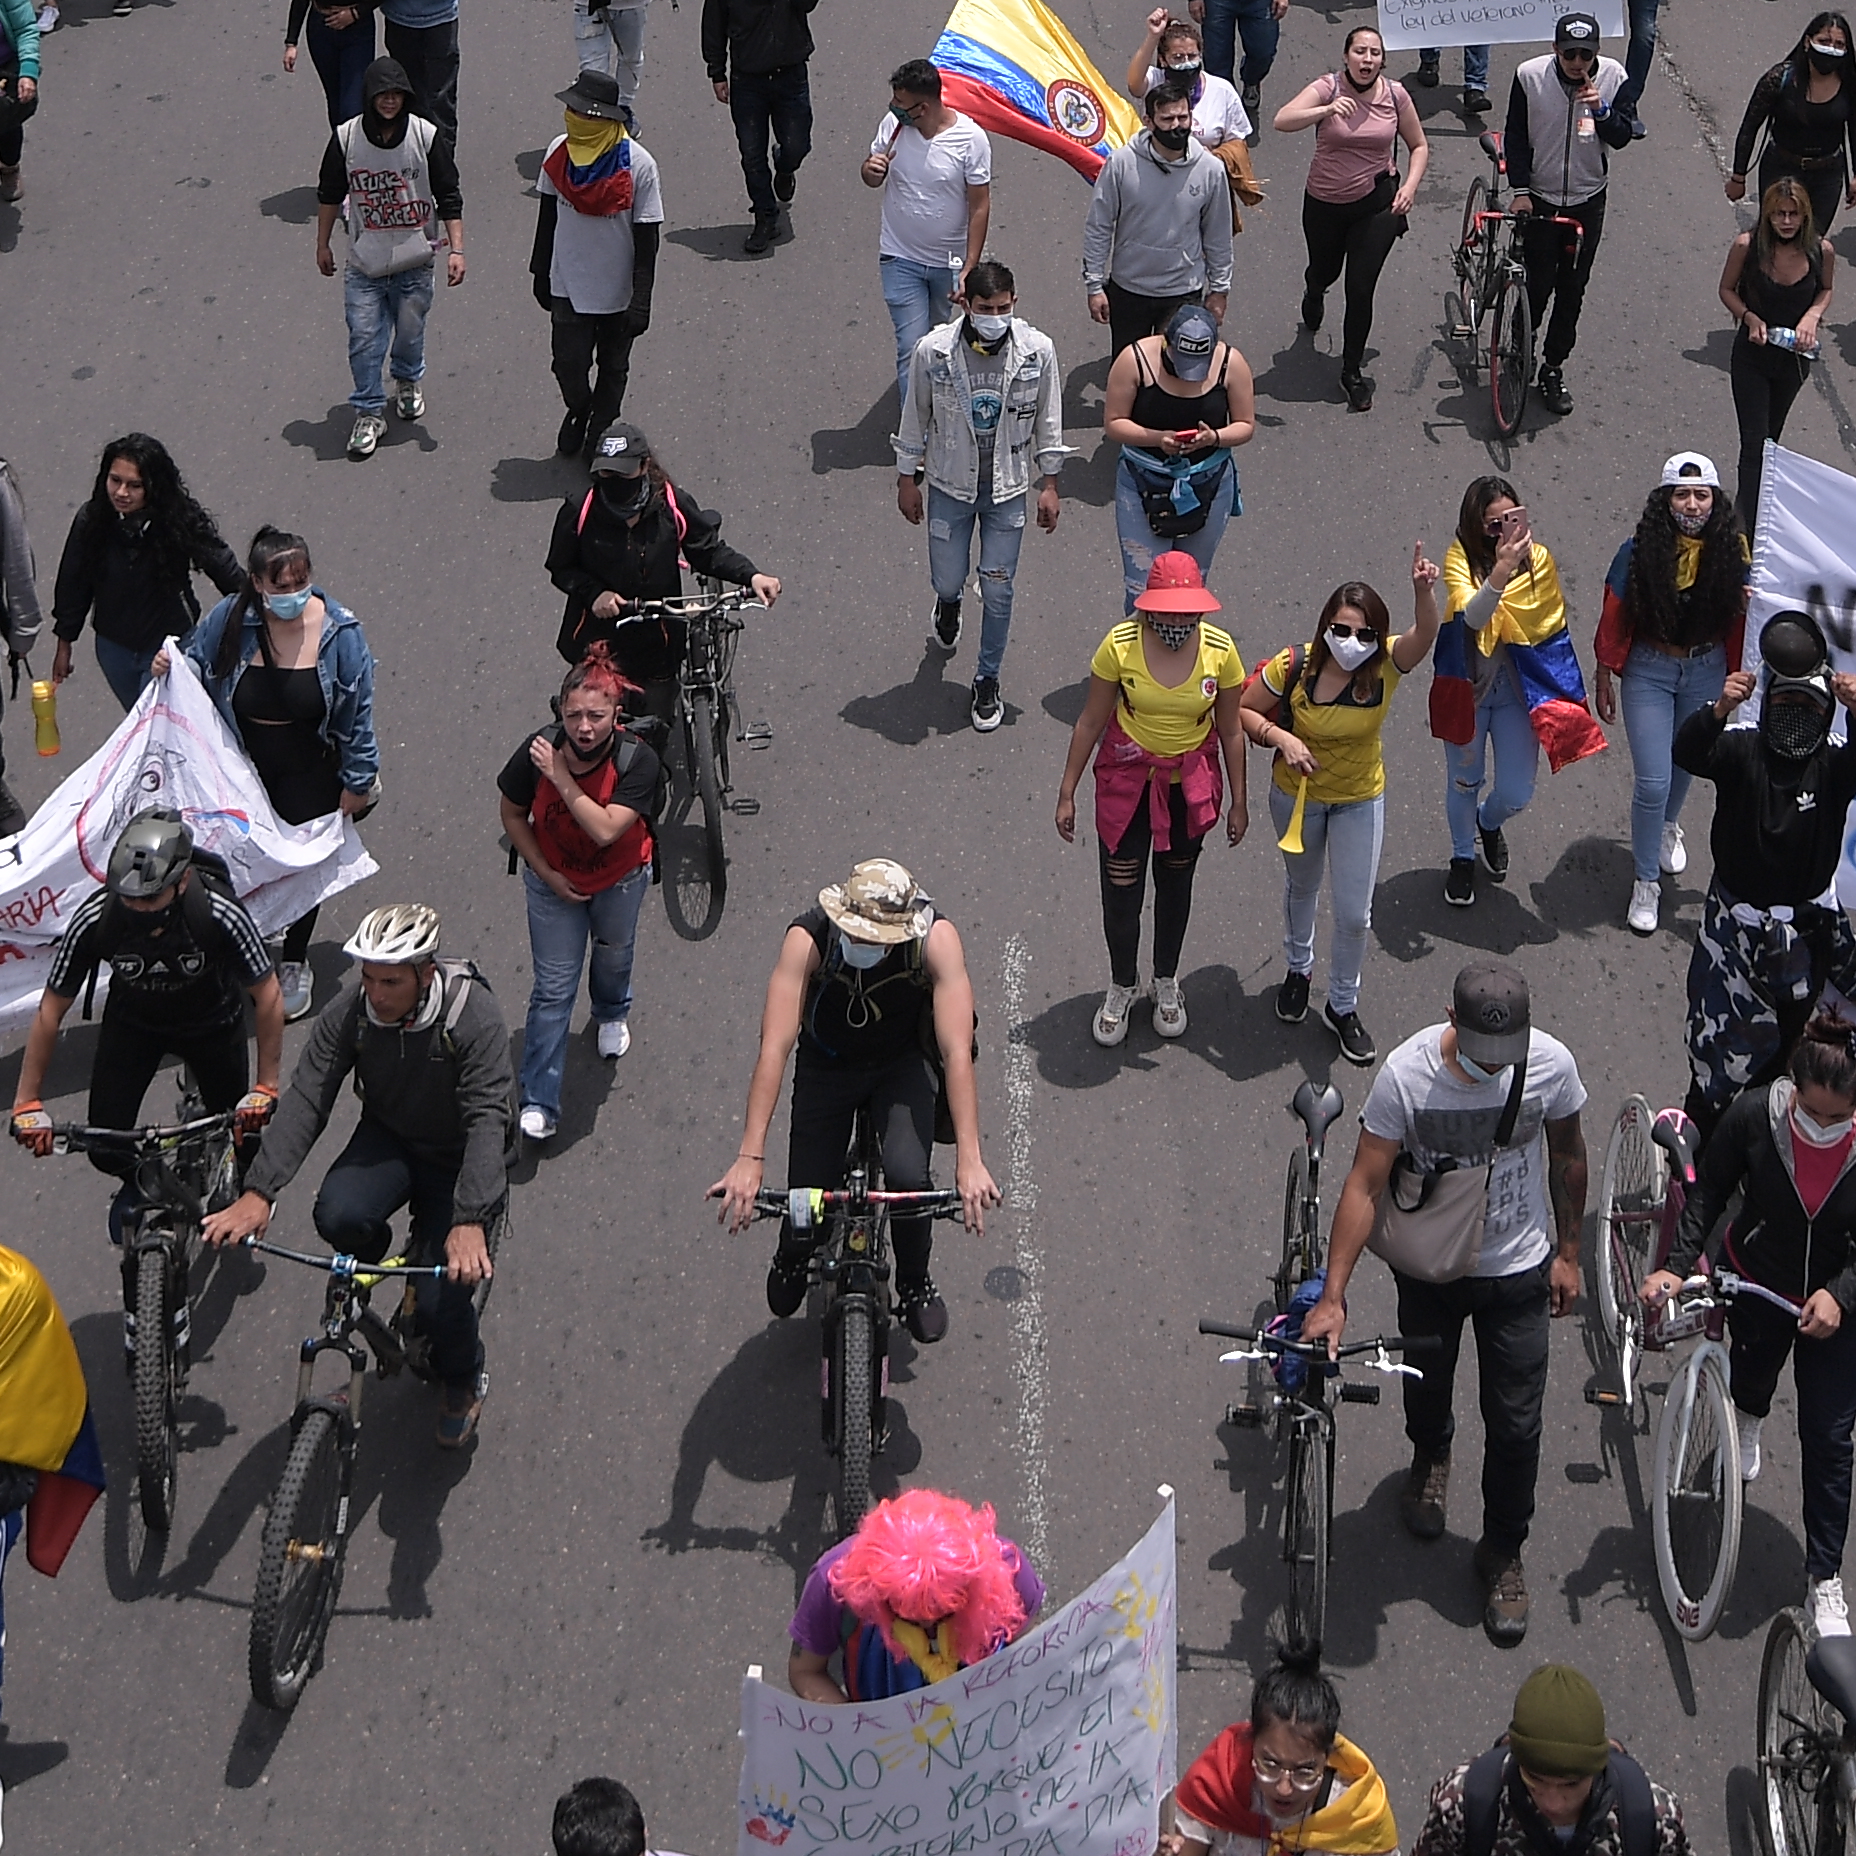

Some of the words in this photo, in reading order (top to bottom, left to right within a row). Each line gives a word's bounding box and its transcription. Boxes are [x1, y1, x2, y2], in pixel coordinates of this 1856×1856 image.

[368, 189, 400, 206] THE
[962, 1600, 1105, 1703] REFORMA
[794, 1742, 883, 1792] NO
[925, 1640, 1115, 1779] NECESITO
[852, 1709, 892, 1735] A
[796, 1794, 922, 1844] SEXO
[947, 1730, 1067, 1823] PORQUE
